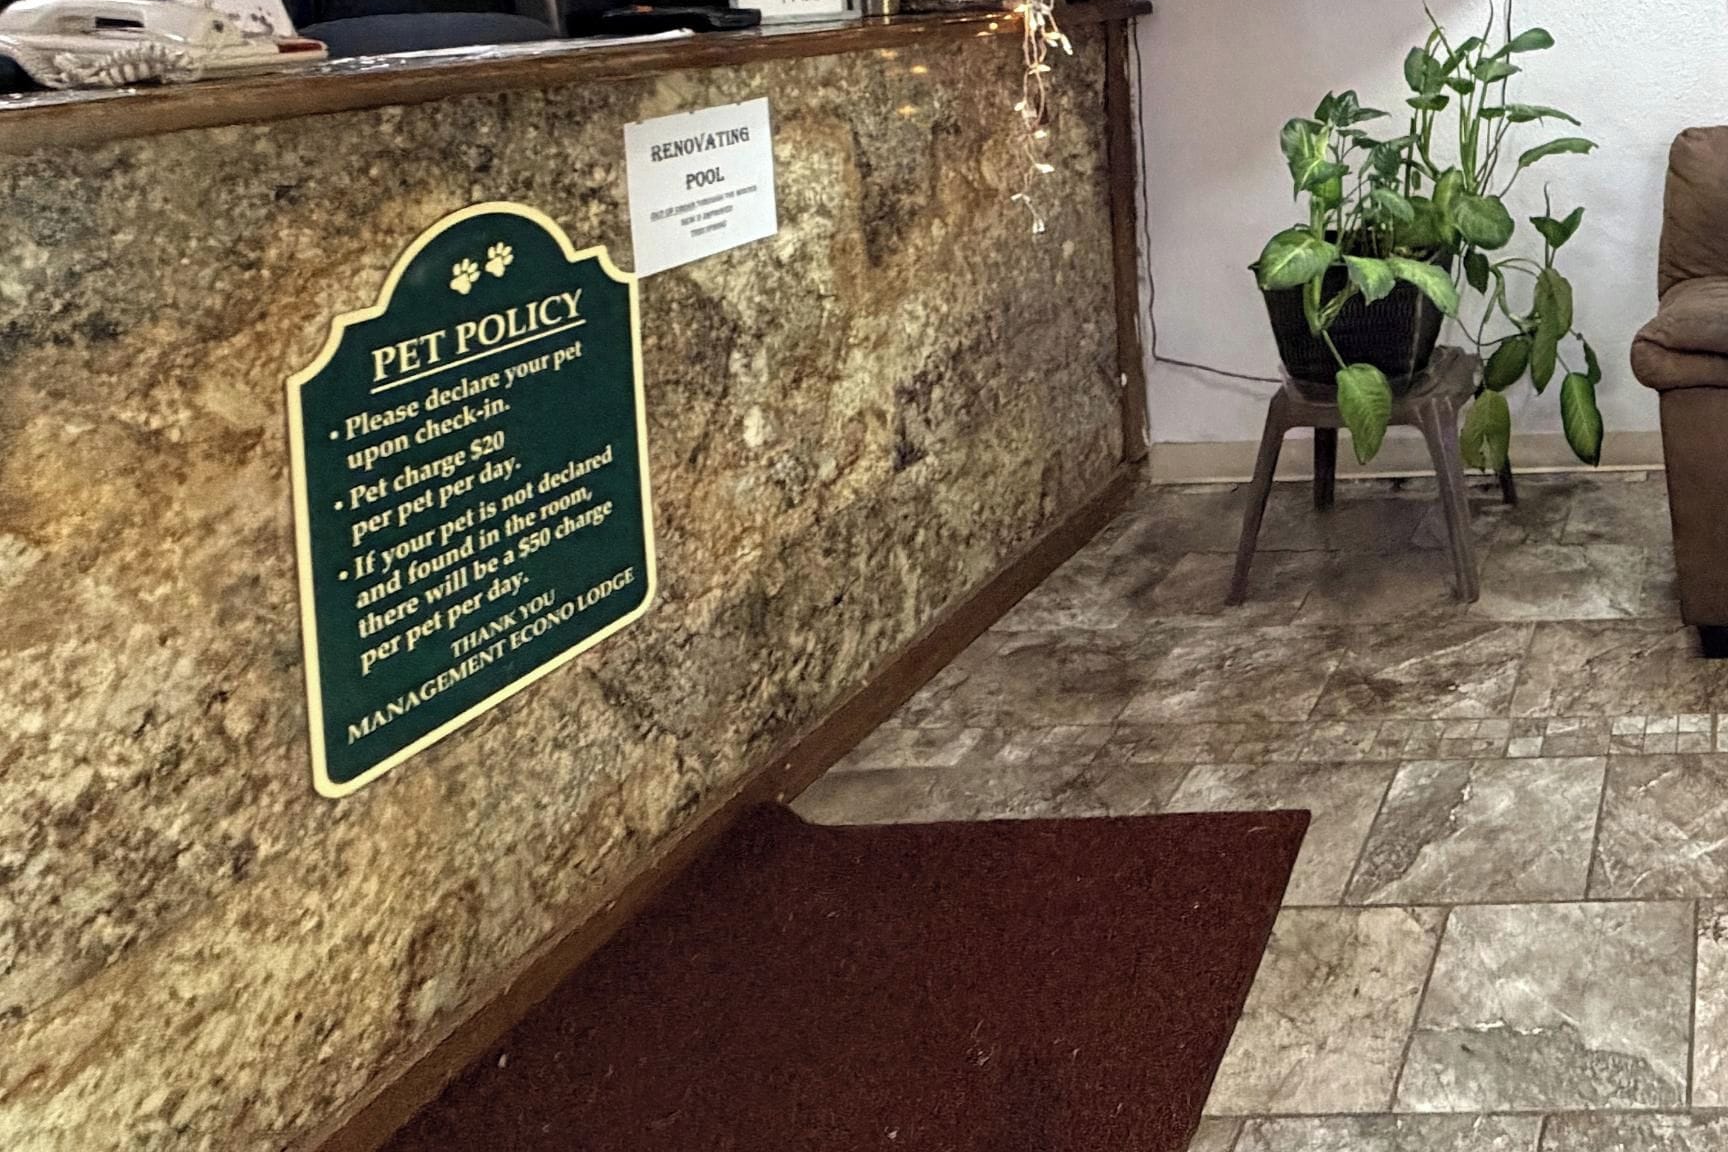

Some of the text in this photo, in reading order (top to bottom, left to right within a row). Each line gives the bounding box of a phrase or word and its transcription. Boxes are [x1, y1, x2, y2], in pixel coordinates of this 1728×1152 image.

[650, 127, 750, 162] RENOVATING
[685, 166, 725, 190] POOL
[371, 288, 584, 382] PET POLICY
[345, 340, 583, 441] Please declare your pet
[347, 397, 511, 471] upon check-in.
[349, 430, 506, 511] Pet charge $20
[351, 455, 522, 548] per pet per day.
[354, 445, 614, 581] If your pet is not declared
[355, 486, 593, 609] and found in the room,
[357, 499, 614, 640] there will be a $50 charge
[347, 566, 636, 746] MANAGEMENT ECONO LODGE
[360, 569, 530, 677] per pet per day.
[449, 588, 557, 659] THANK YOU
